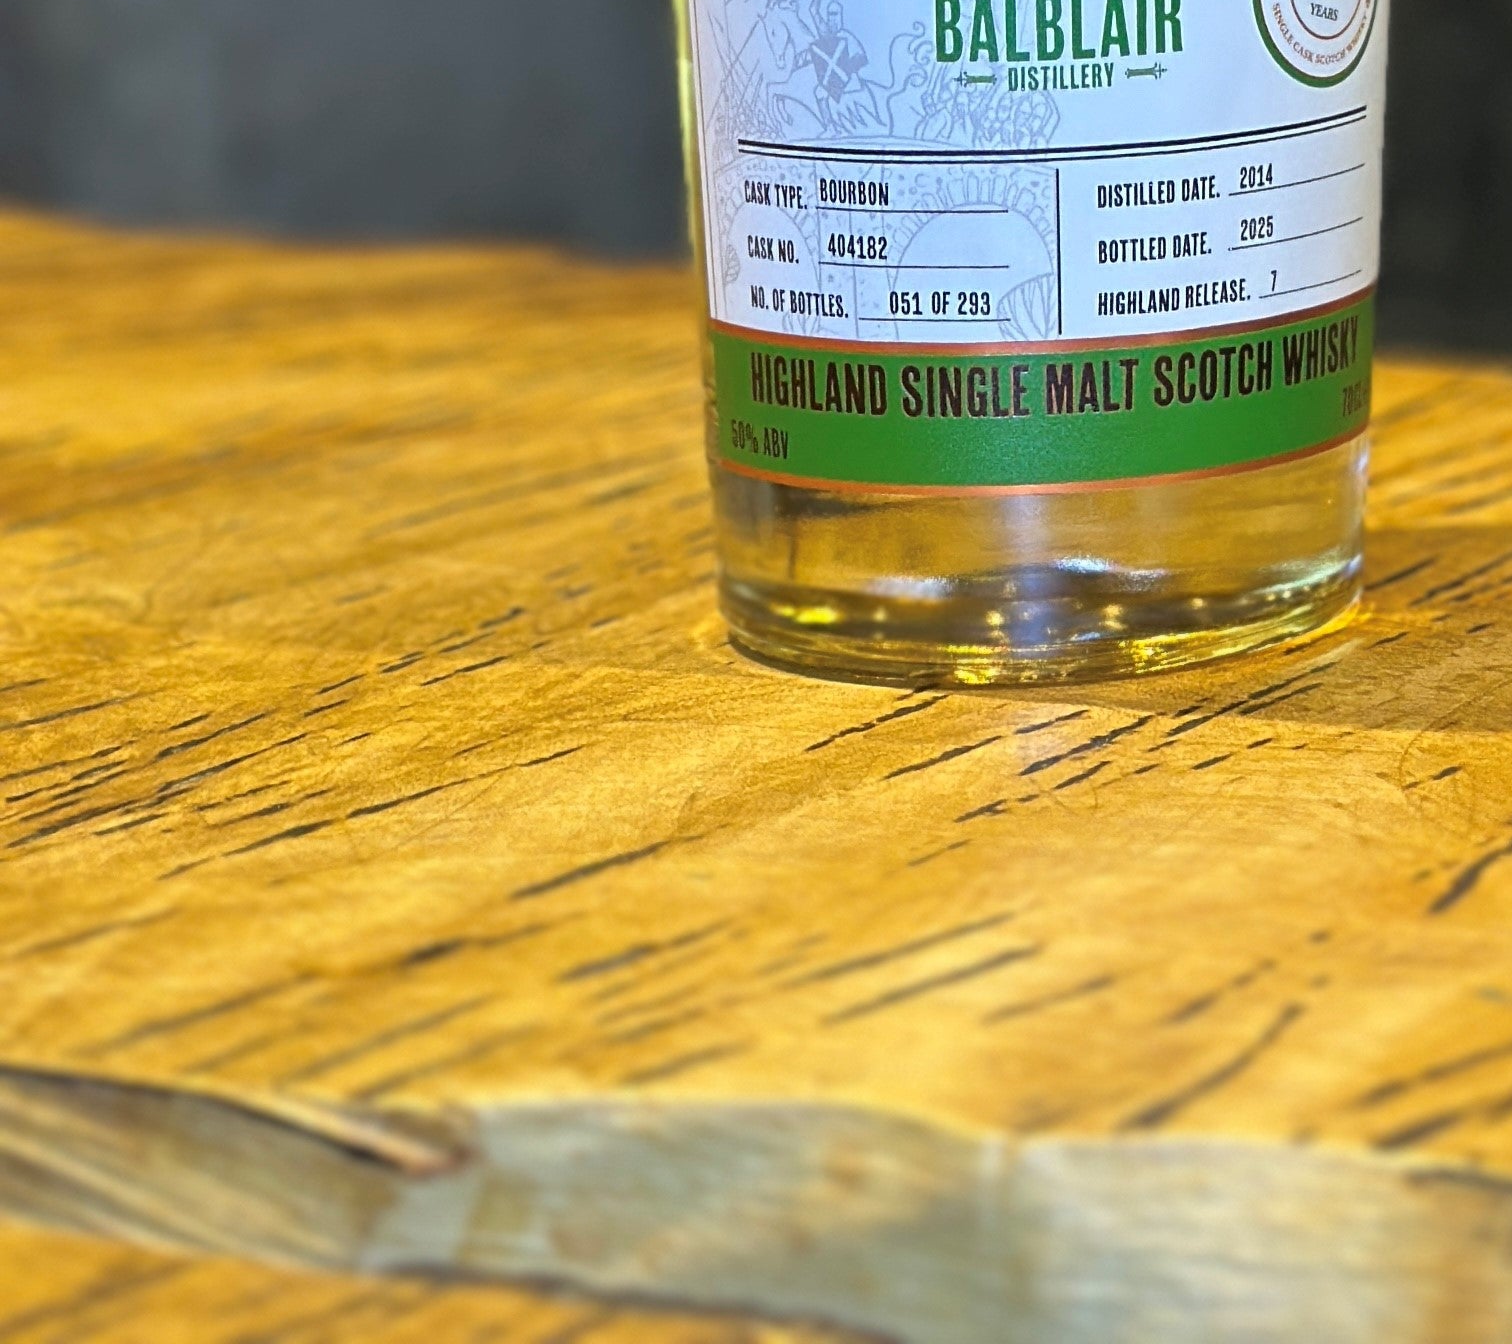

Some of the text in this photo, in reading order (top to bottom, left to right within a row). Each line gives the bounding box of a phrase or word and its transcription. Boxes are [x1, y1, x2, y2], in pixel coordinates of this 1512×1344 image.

[1310, 2, 1339, 21] YEARS
[1007, 62, 1115, 91] DISTILLERY
[744, 178, 889, 210] CASK TYPE. BOURBON
[1097, 163, 1273, 208] DISTILLED DATE. 2014
[747, 233, 888, 264] CASK NO. 404182
[1098, 215, 1274, 264] BOTTLED DATE. 2025
[750, 285, 991, 319] NO. OF BOTTLES. 051 OF 293
[1097, 270, 1278, 316] HIGHLAND RELEASE. 7
[751, 315, 1358, 418] HIGHLAND SINGLE MALT SCOTCH WHISKY
[730, 419, 789, 459] 50% ABV
